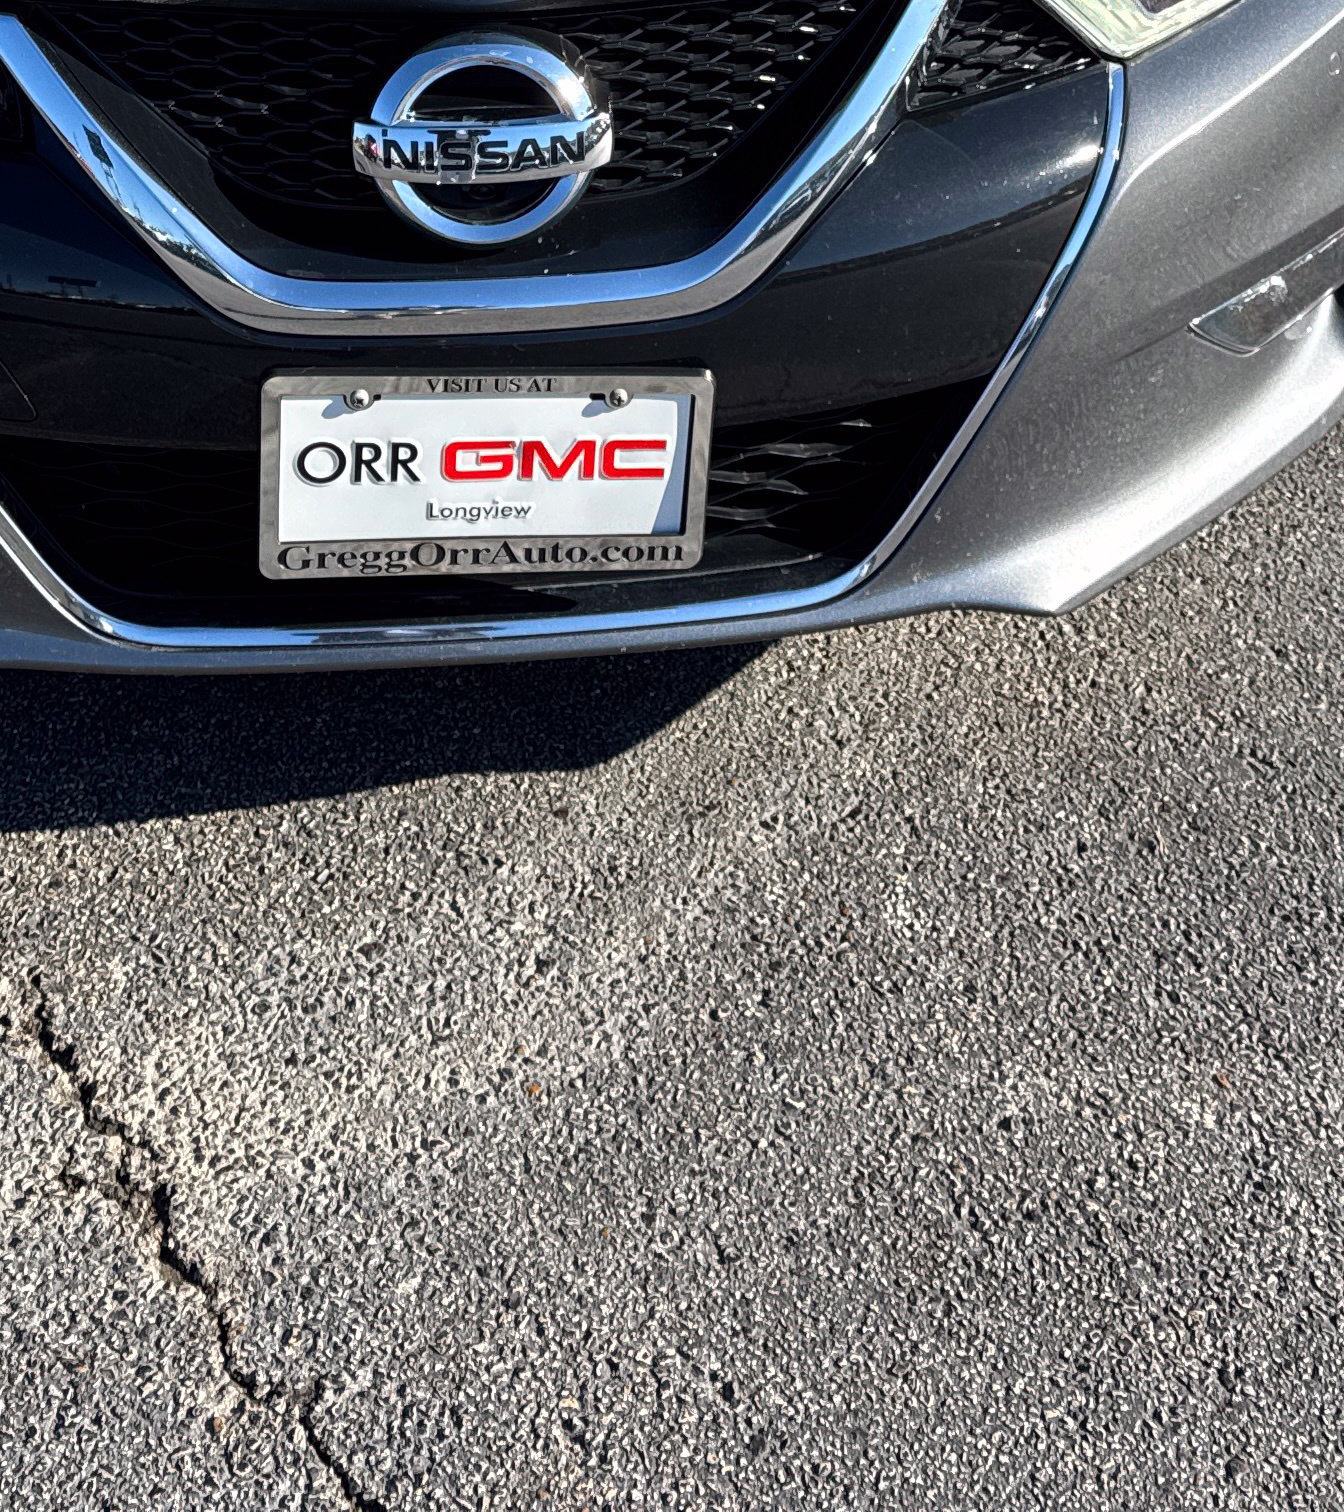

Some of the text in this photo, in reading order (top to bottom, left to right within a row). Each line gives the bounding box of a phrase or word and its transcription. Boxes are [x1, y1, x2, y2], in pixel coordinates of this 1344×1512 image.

[383, 131, 586, 173] NISSAN
[426, 377, 557, 393] VISIT US AT
[296, 439, 668, 485] ORR GMC
[426, 499, 533, 522] Longview
[276, 541, 684, 576] GreggOrrAuto.com
